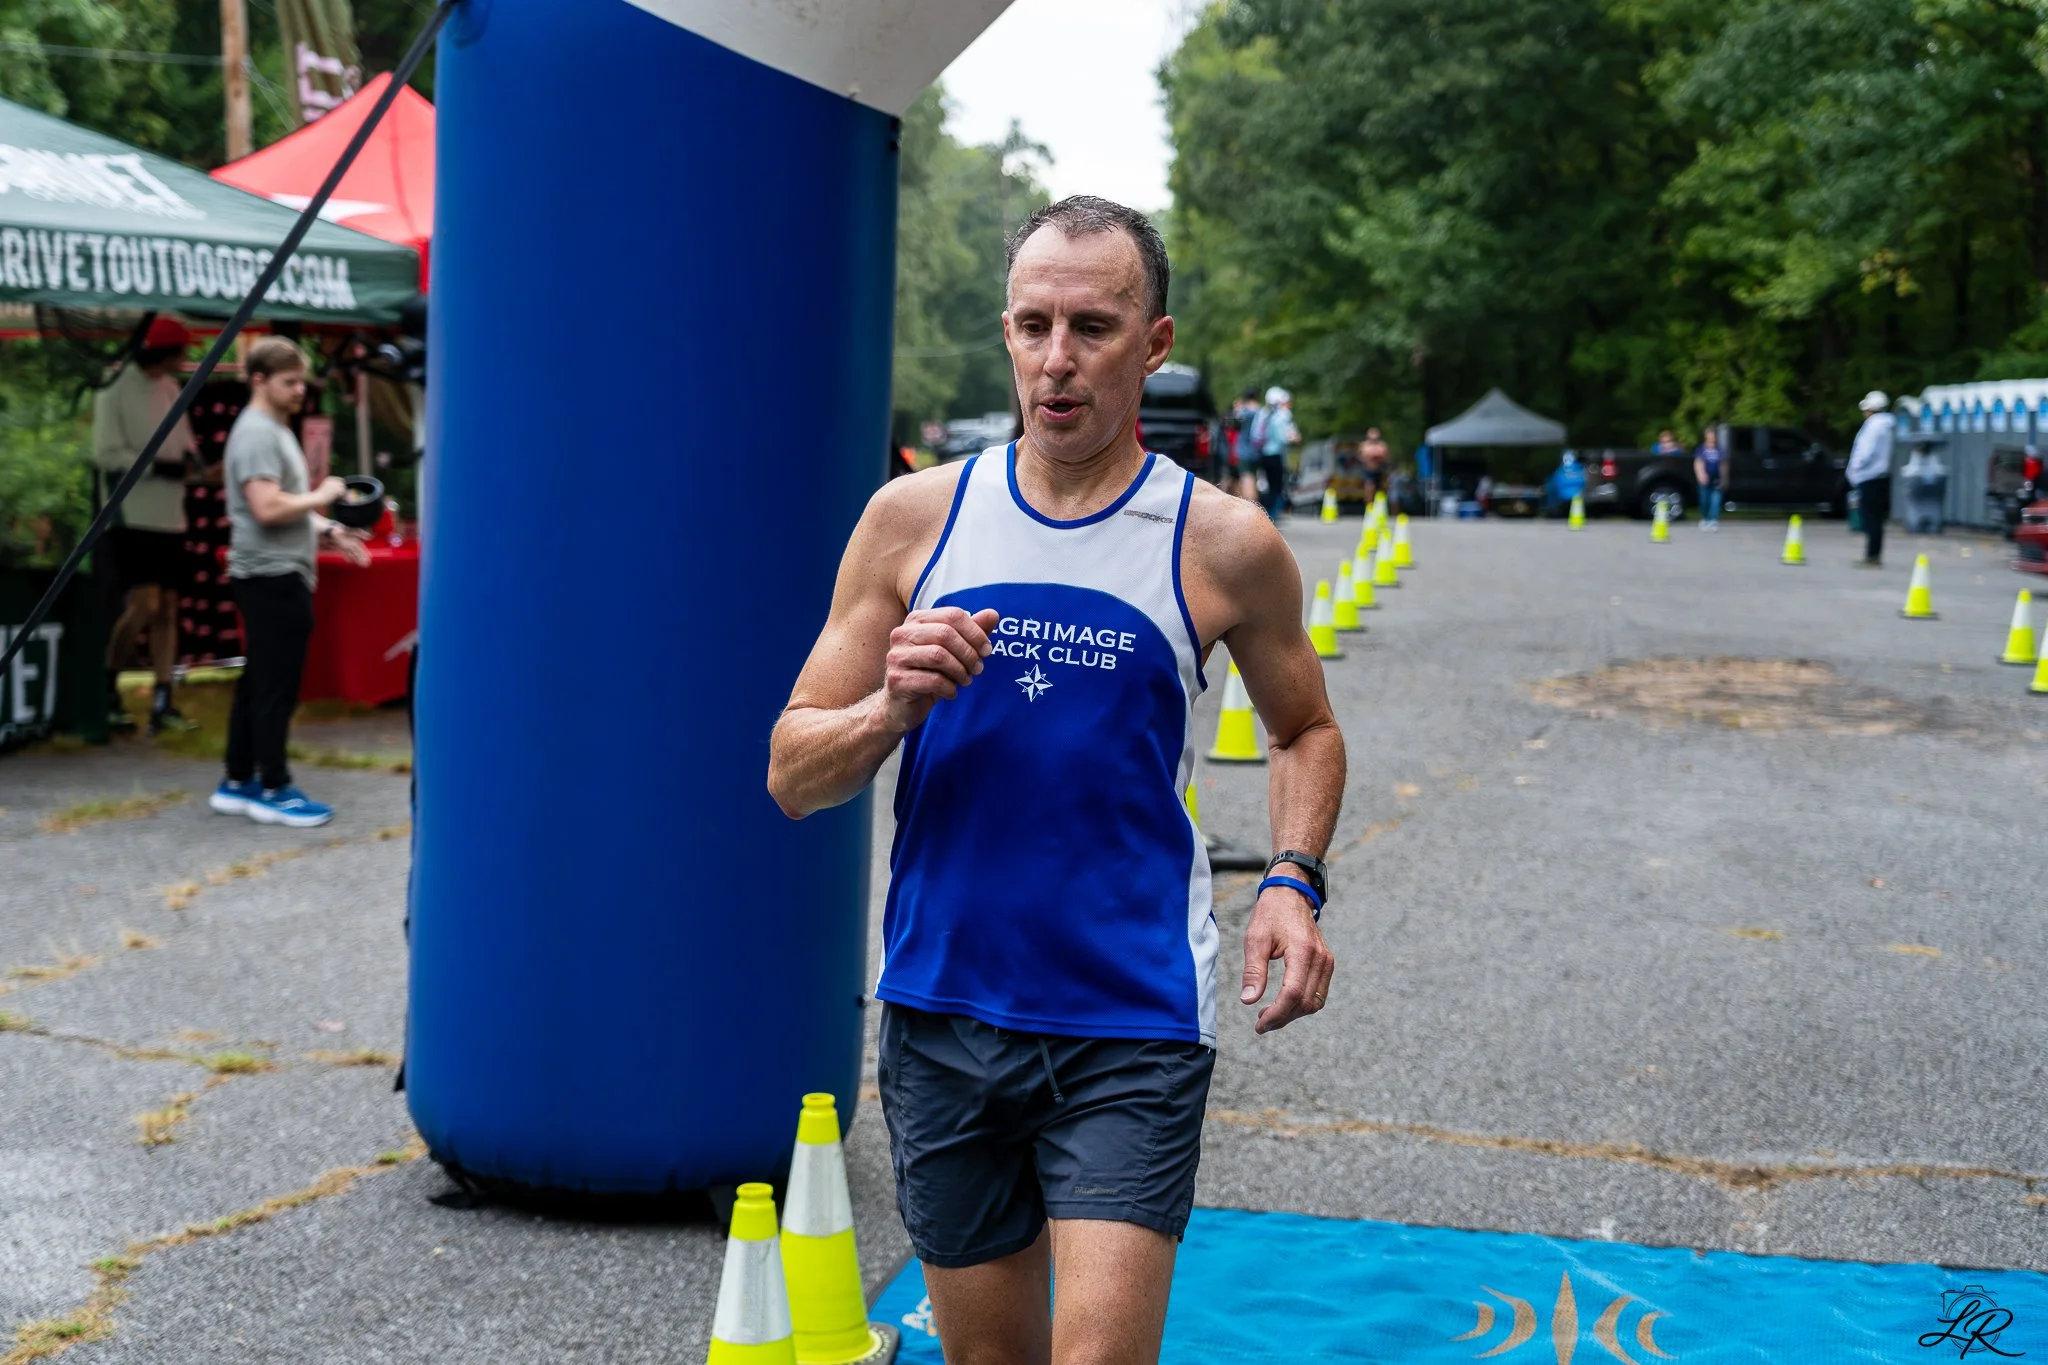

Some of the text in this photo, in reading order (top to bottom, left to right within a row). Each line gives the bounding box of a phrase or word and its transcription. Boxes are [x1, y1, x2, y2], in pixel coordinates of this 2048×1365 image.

[0, 228, 356, 310] RIVETOUTDOORS.COM
[1123, 509, 1173, 523] BROOKS
[992, 617, 1137, 652] GRIMAGE
[992, 639, 1117, 670] ACK CLUB
